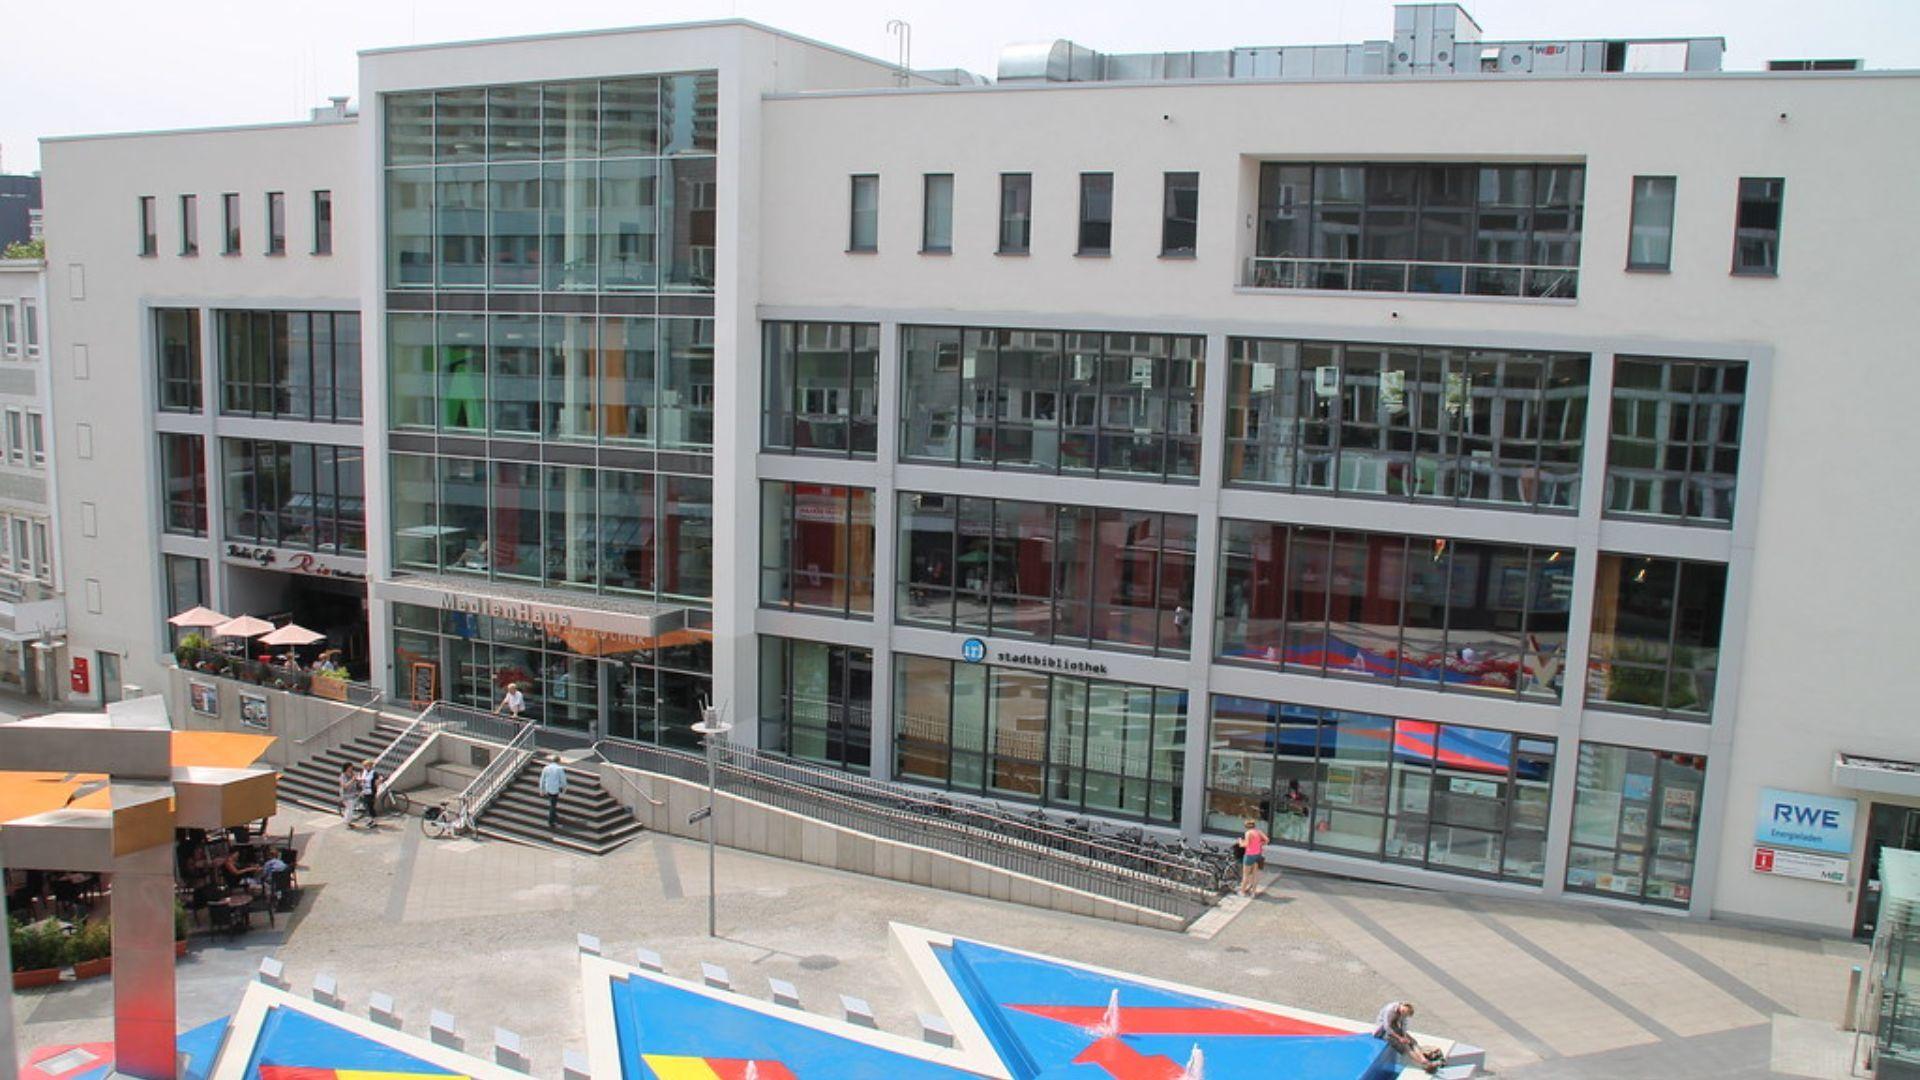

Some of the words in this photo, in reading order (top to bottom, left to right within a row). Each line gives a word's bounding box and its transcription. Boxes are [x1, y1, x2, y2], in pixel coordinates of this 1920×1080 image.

[441, 592, 571, 625] MedienHaus
[997, 652, 1107, 674] stadtbibliothek
[1773, 803, 1841, 829] RWE
